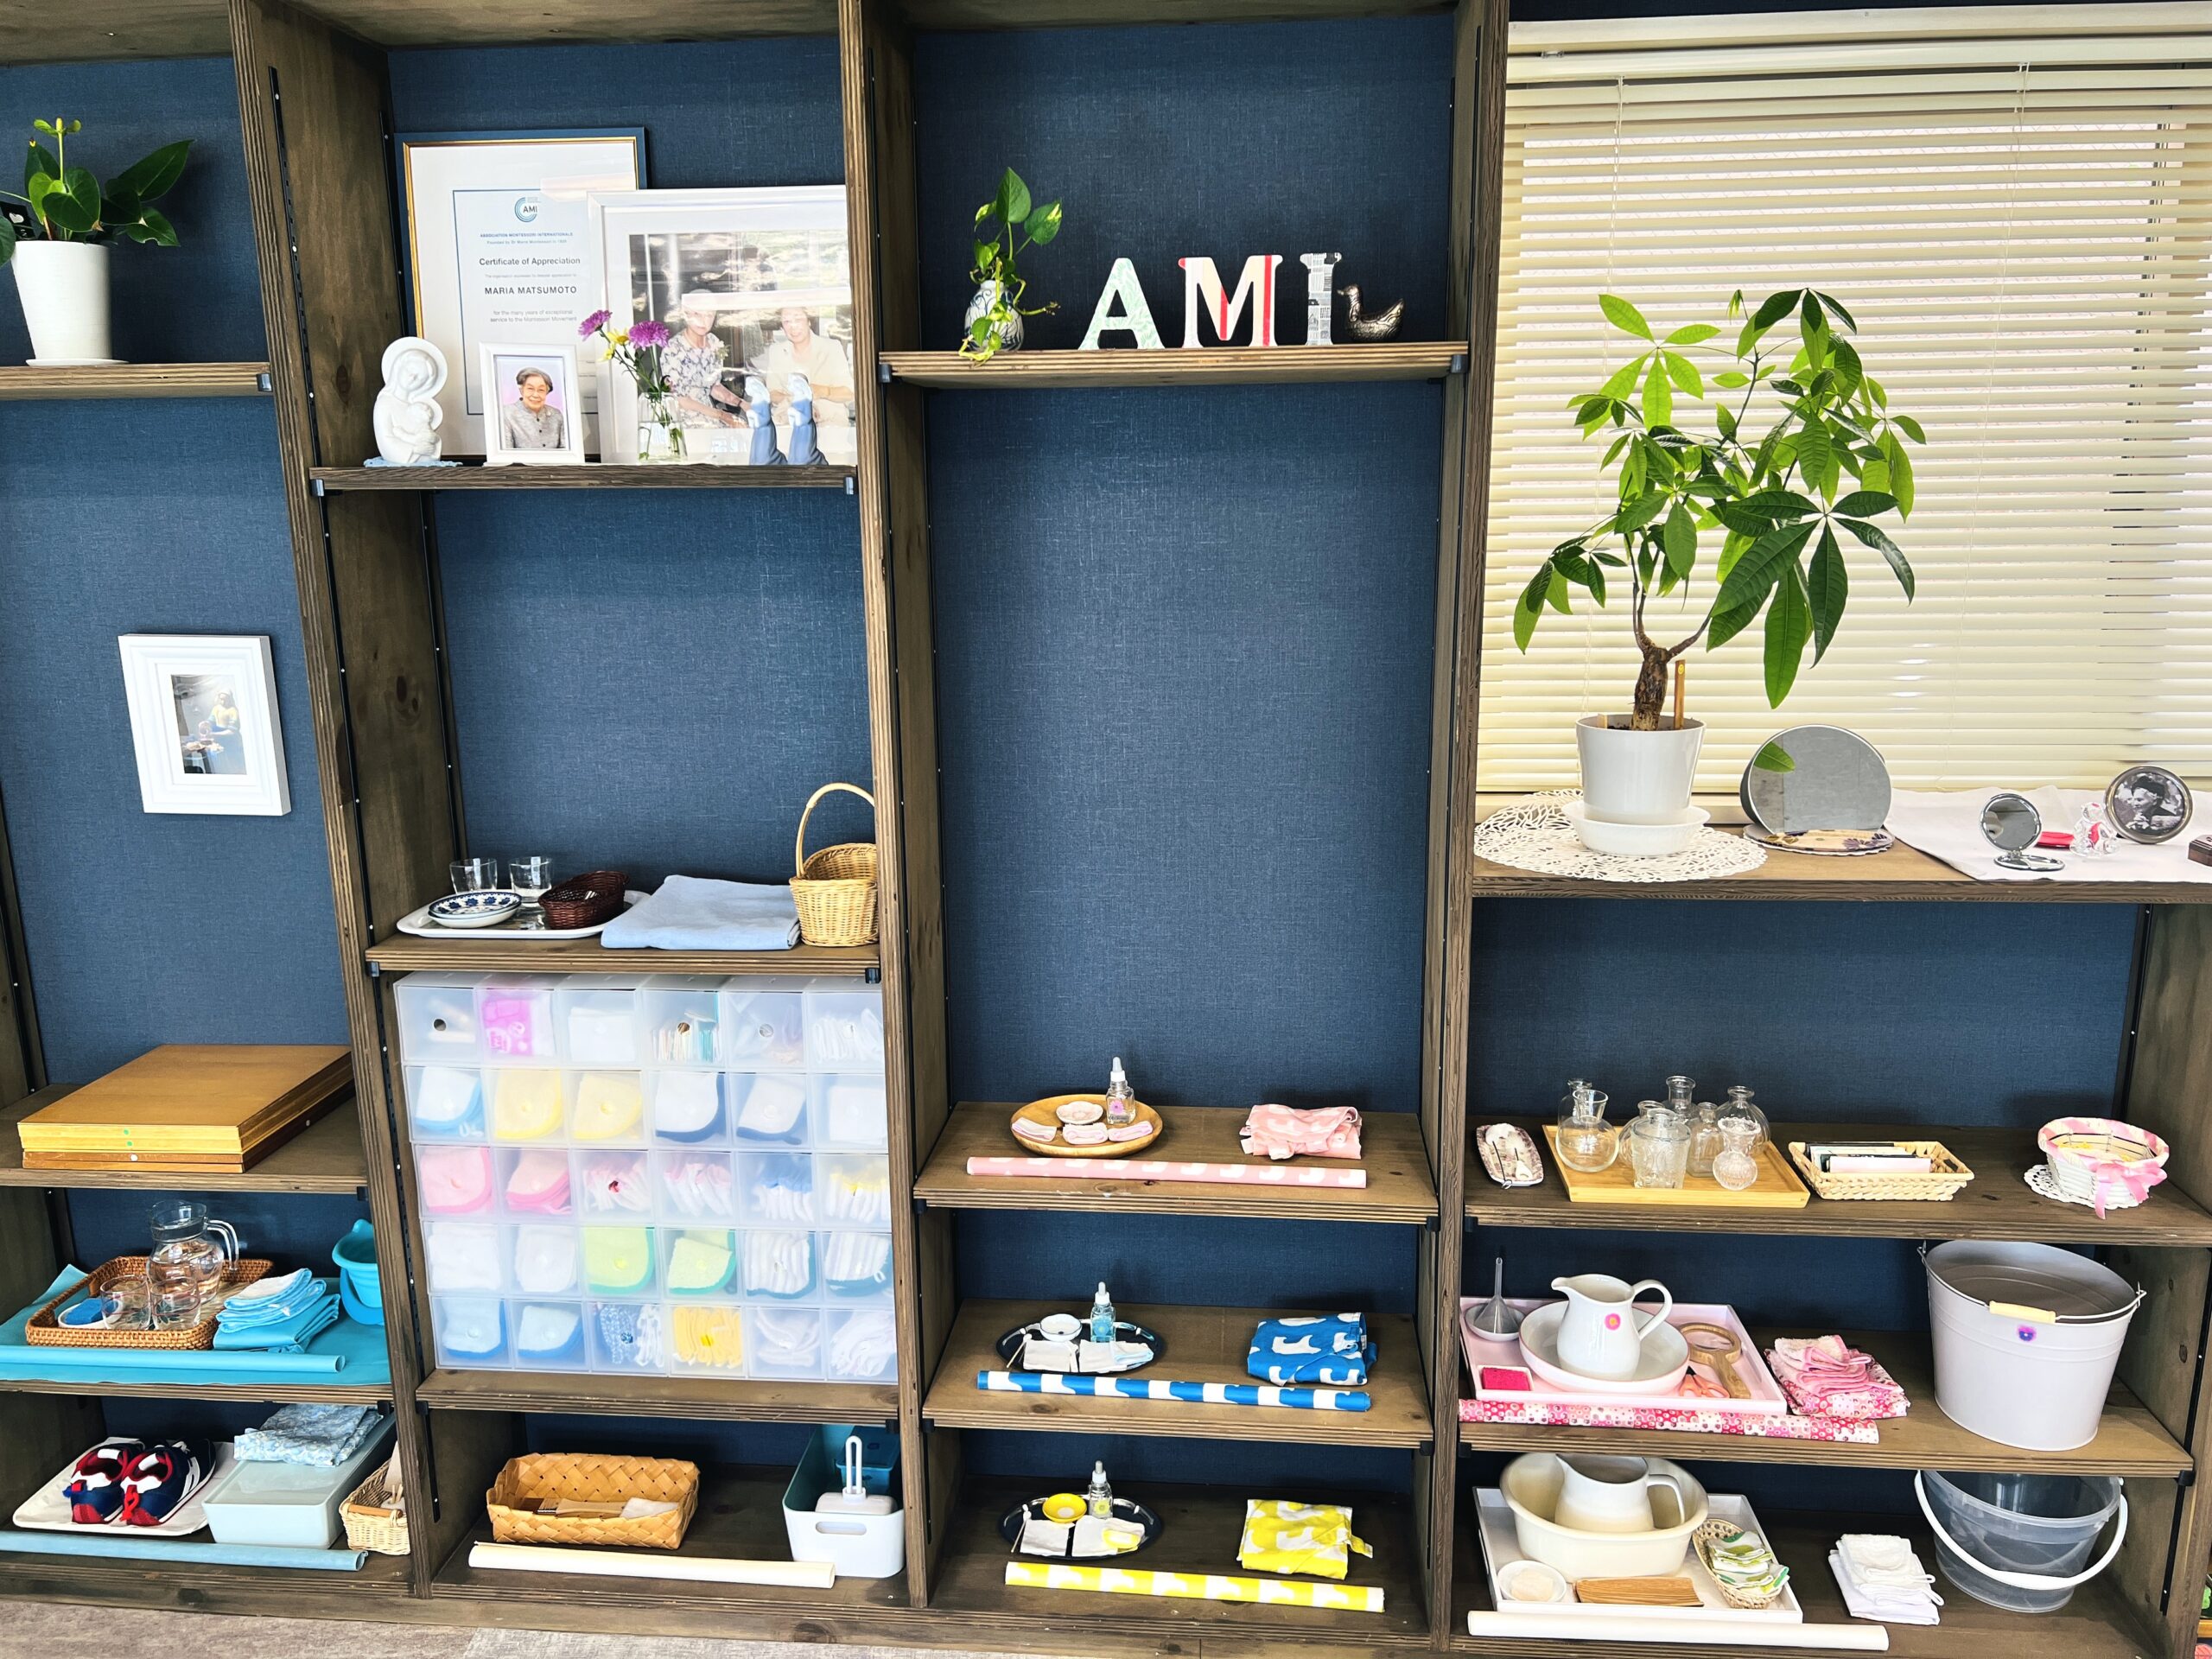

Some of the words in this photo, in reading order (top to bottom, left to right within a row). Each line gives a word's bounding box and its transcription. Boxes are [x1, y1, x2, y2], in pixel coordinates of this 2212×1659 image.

[479, 257, 520, 266] Certificate
[531, 257, 581, 266] Appreciation
[518, 286, 577, 295] MATSUMOTO
[1077, 252, 1342, 350] AMI
